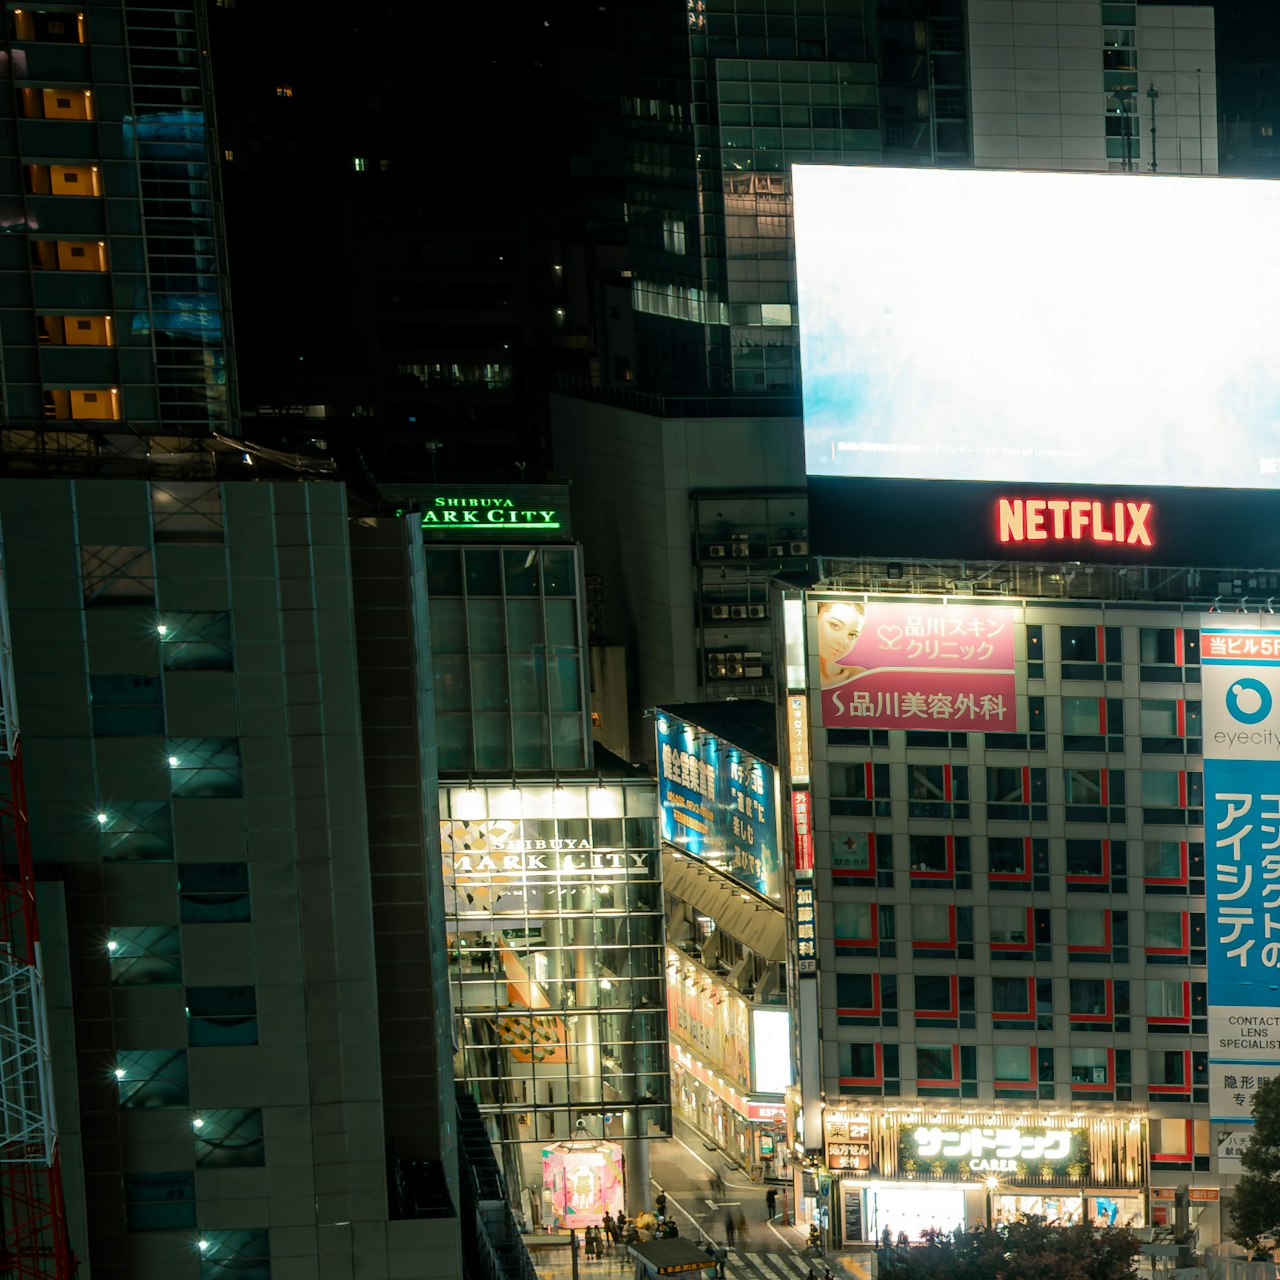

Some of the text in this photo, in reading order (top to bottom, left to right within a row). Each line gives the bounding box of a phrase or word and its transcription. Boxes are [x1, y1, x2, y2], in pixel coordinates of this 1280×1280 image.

[435, 497, 514, 507] SHIBUYA
[405, 509, 556, 522] ARK CITY
[998, 499, 1152, 546] NETFLIX
[905, 618, 1005, 637] 品川スキン
[906, 640, 996, 661] クリニック
[849, 692, 1008, 721] 品川美容外科
[492, 839, 592, 851] SHIBUYA
[441, 853, 548, 870] MARK
[1214, 793, 1254, 969] アイシティ
[1228, 1015, 1280, 1027] CONTACT
[1240, 1027, 1269, 1039] LENS
[850, 1126, 869, 1138] 2F
[828, 1144, 869, 1157] 処方せん
[913, 1127, 1073, 1160] サンドラッグ
[969, 1158, 1018, 1172] CARER
